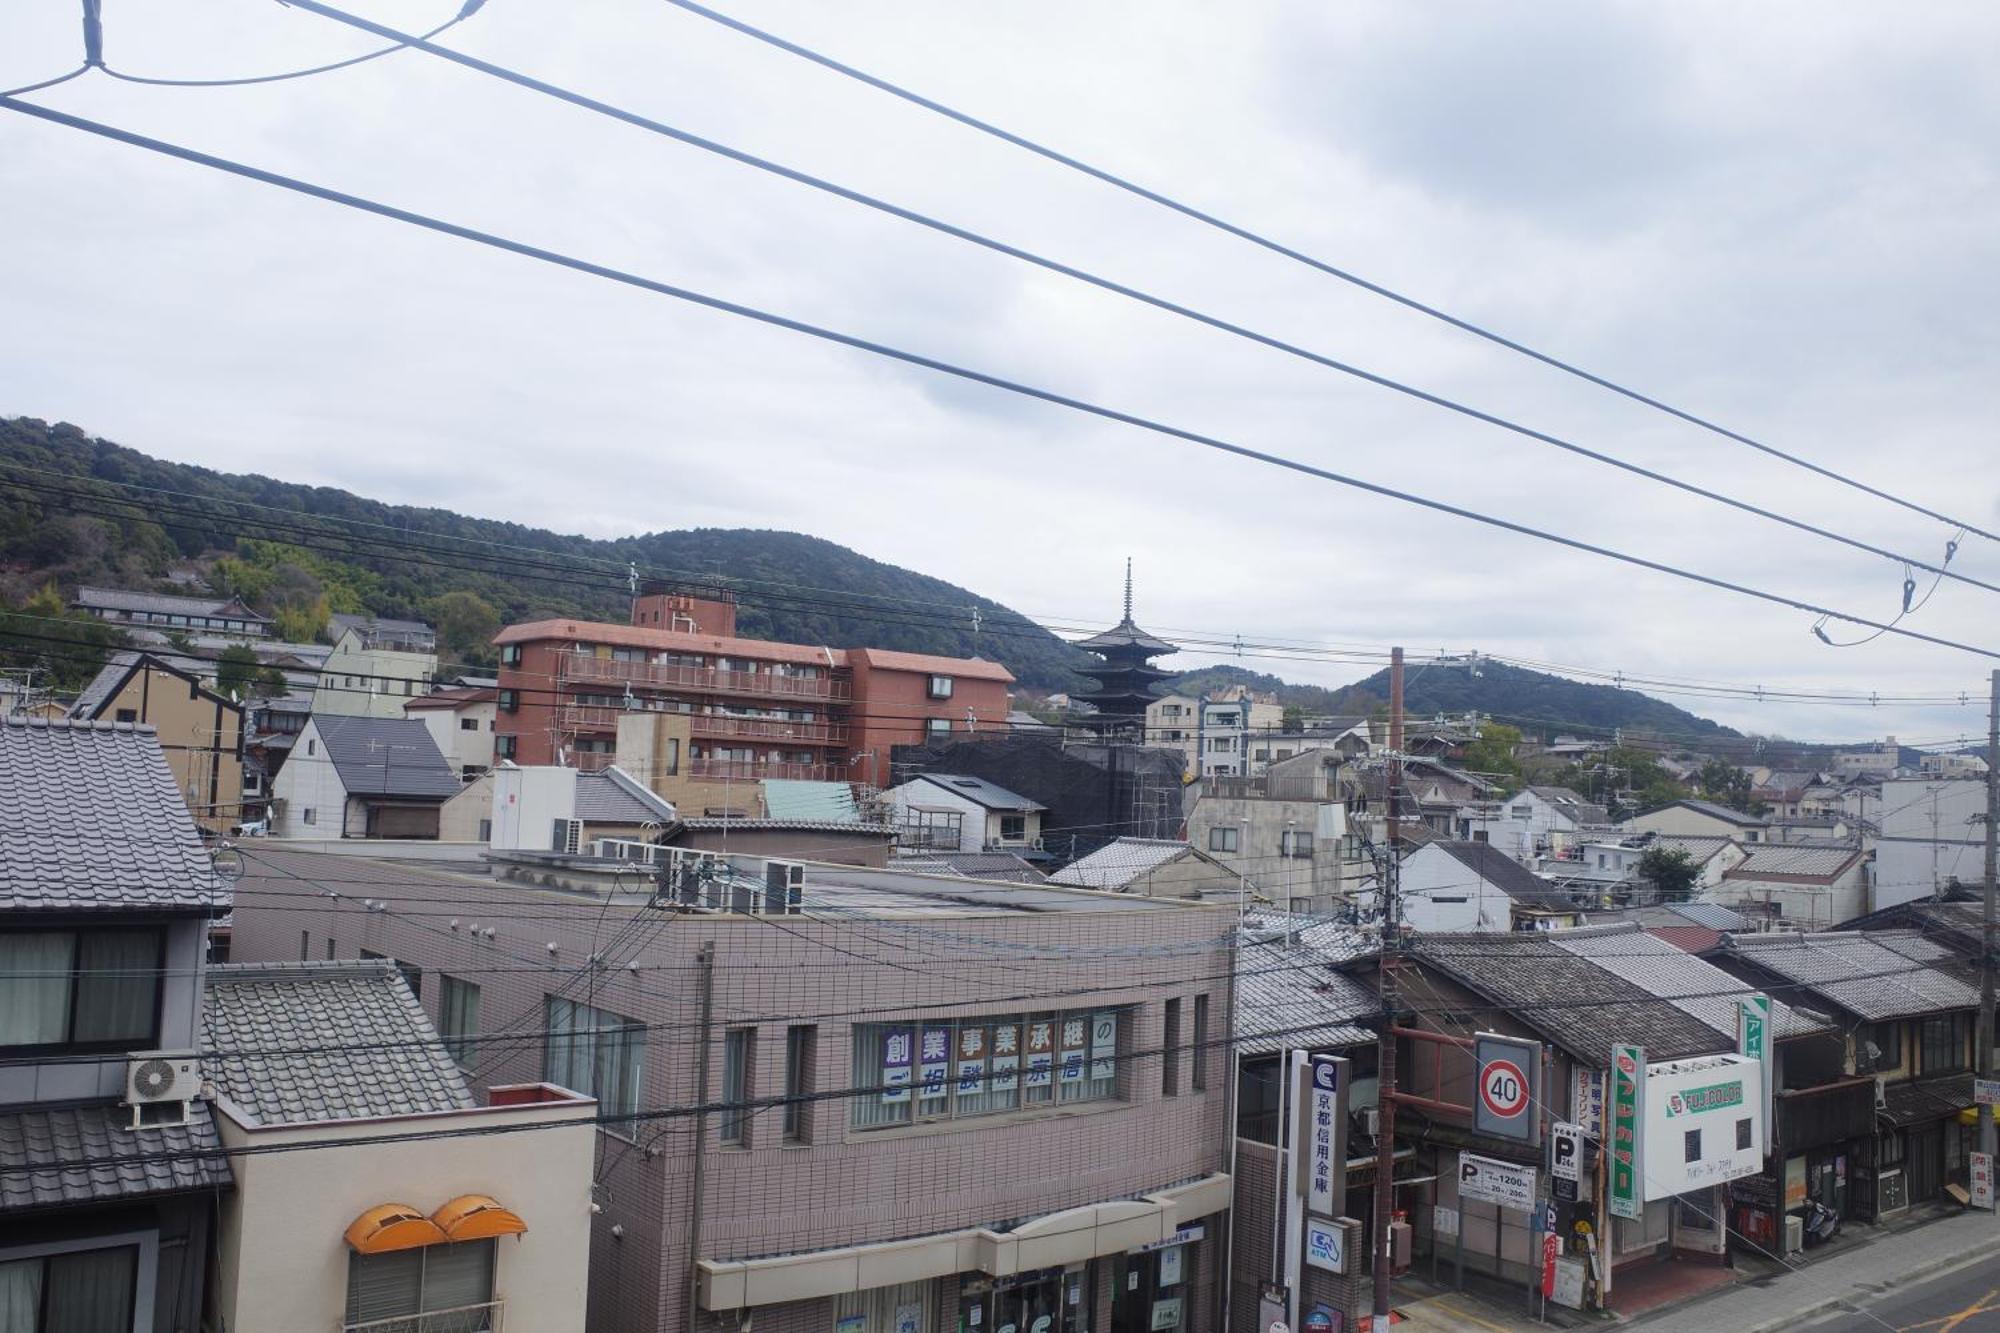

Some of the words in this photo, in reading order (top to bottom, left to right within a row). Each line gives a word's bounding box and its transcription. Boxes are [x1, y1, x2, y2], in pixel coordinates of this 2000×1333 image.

[886, 1020, 1112, 1063] 創業事業承継の
[1491, 1077, 1516, 1102] 40
[1686, 1086, 1741, 1109] FUJICOLOR
[1314, 1093, 1331, 1195] 京都信用金庫
[1555, 1136, 1575, 1164] P
[1462, 1163, 1478, 1181] P
